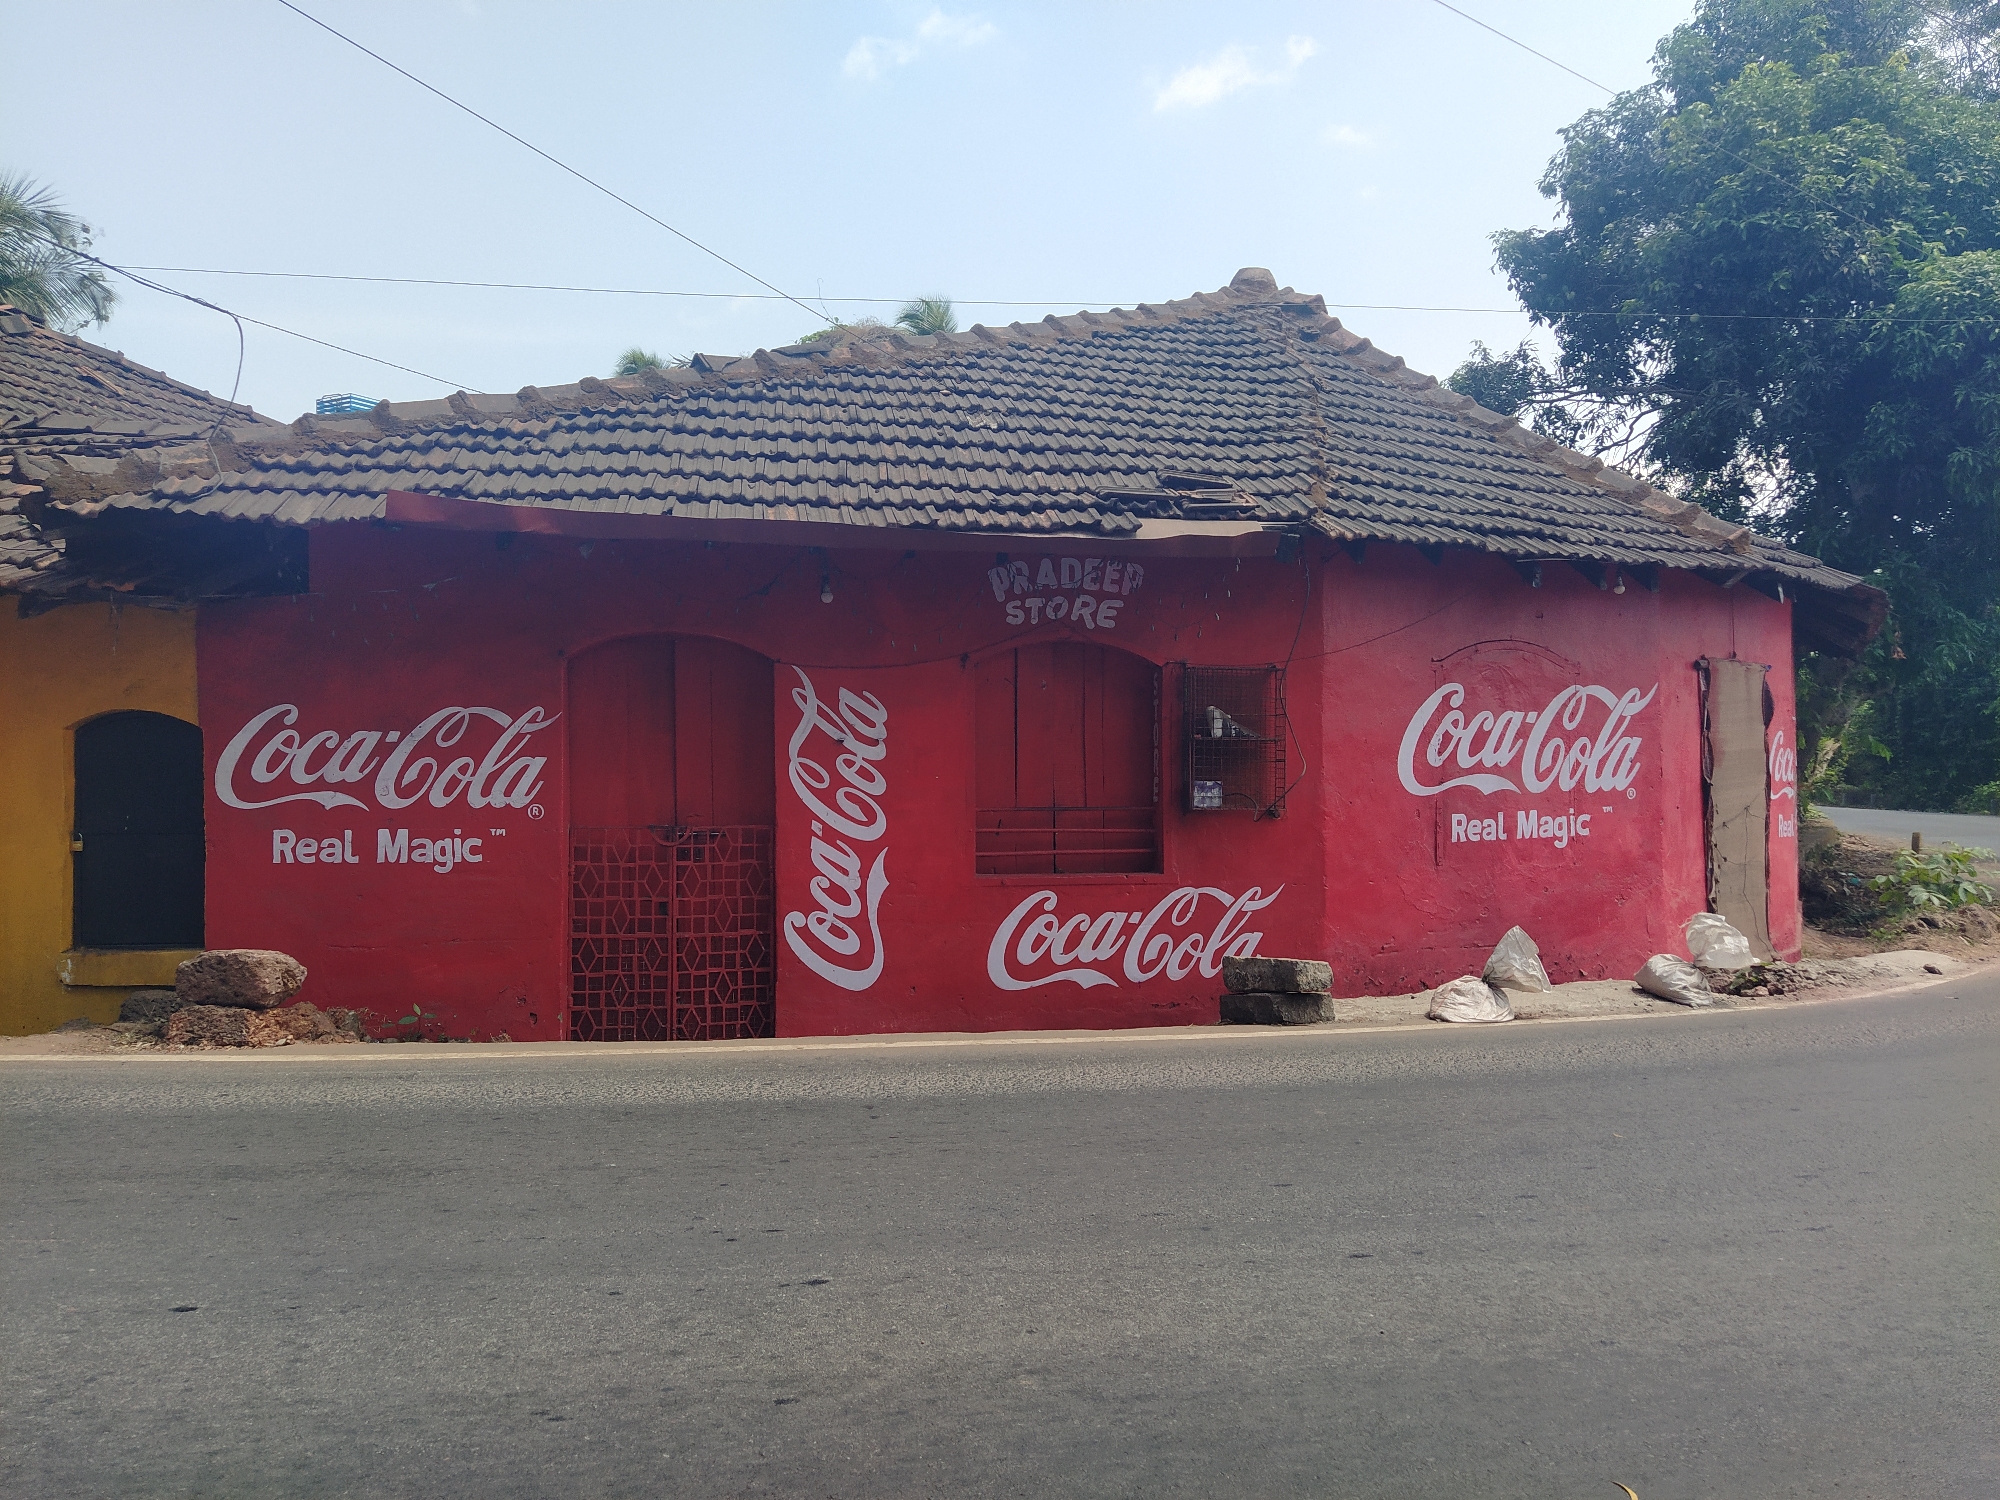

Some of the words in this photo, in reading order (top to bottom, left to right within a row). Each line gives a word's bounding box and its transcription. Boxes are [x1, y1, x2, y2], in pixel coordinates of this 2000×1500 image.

[988, 557, 1144, 602] PRADEEP
[1005, 594, 1124, 629] STORE
[214, 703, 562, 812] Coca-Cola
[1397, 682, 1659, 796] Coca-Cola
[272, 829, 359, 864] Real
[376, 828, 483, 874] Magic
[783, 665, 890, 991] Coca-Cola
[1451, 811, 1507, 843] Real
[1516, 808, 1591, 849] Magic
